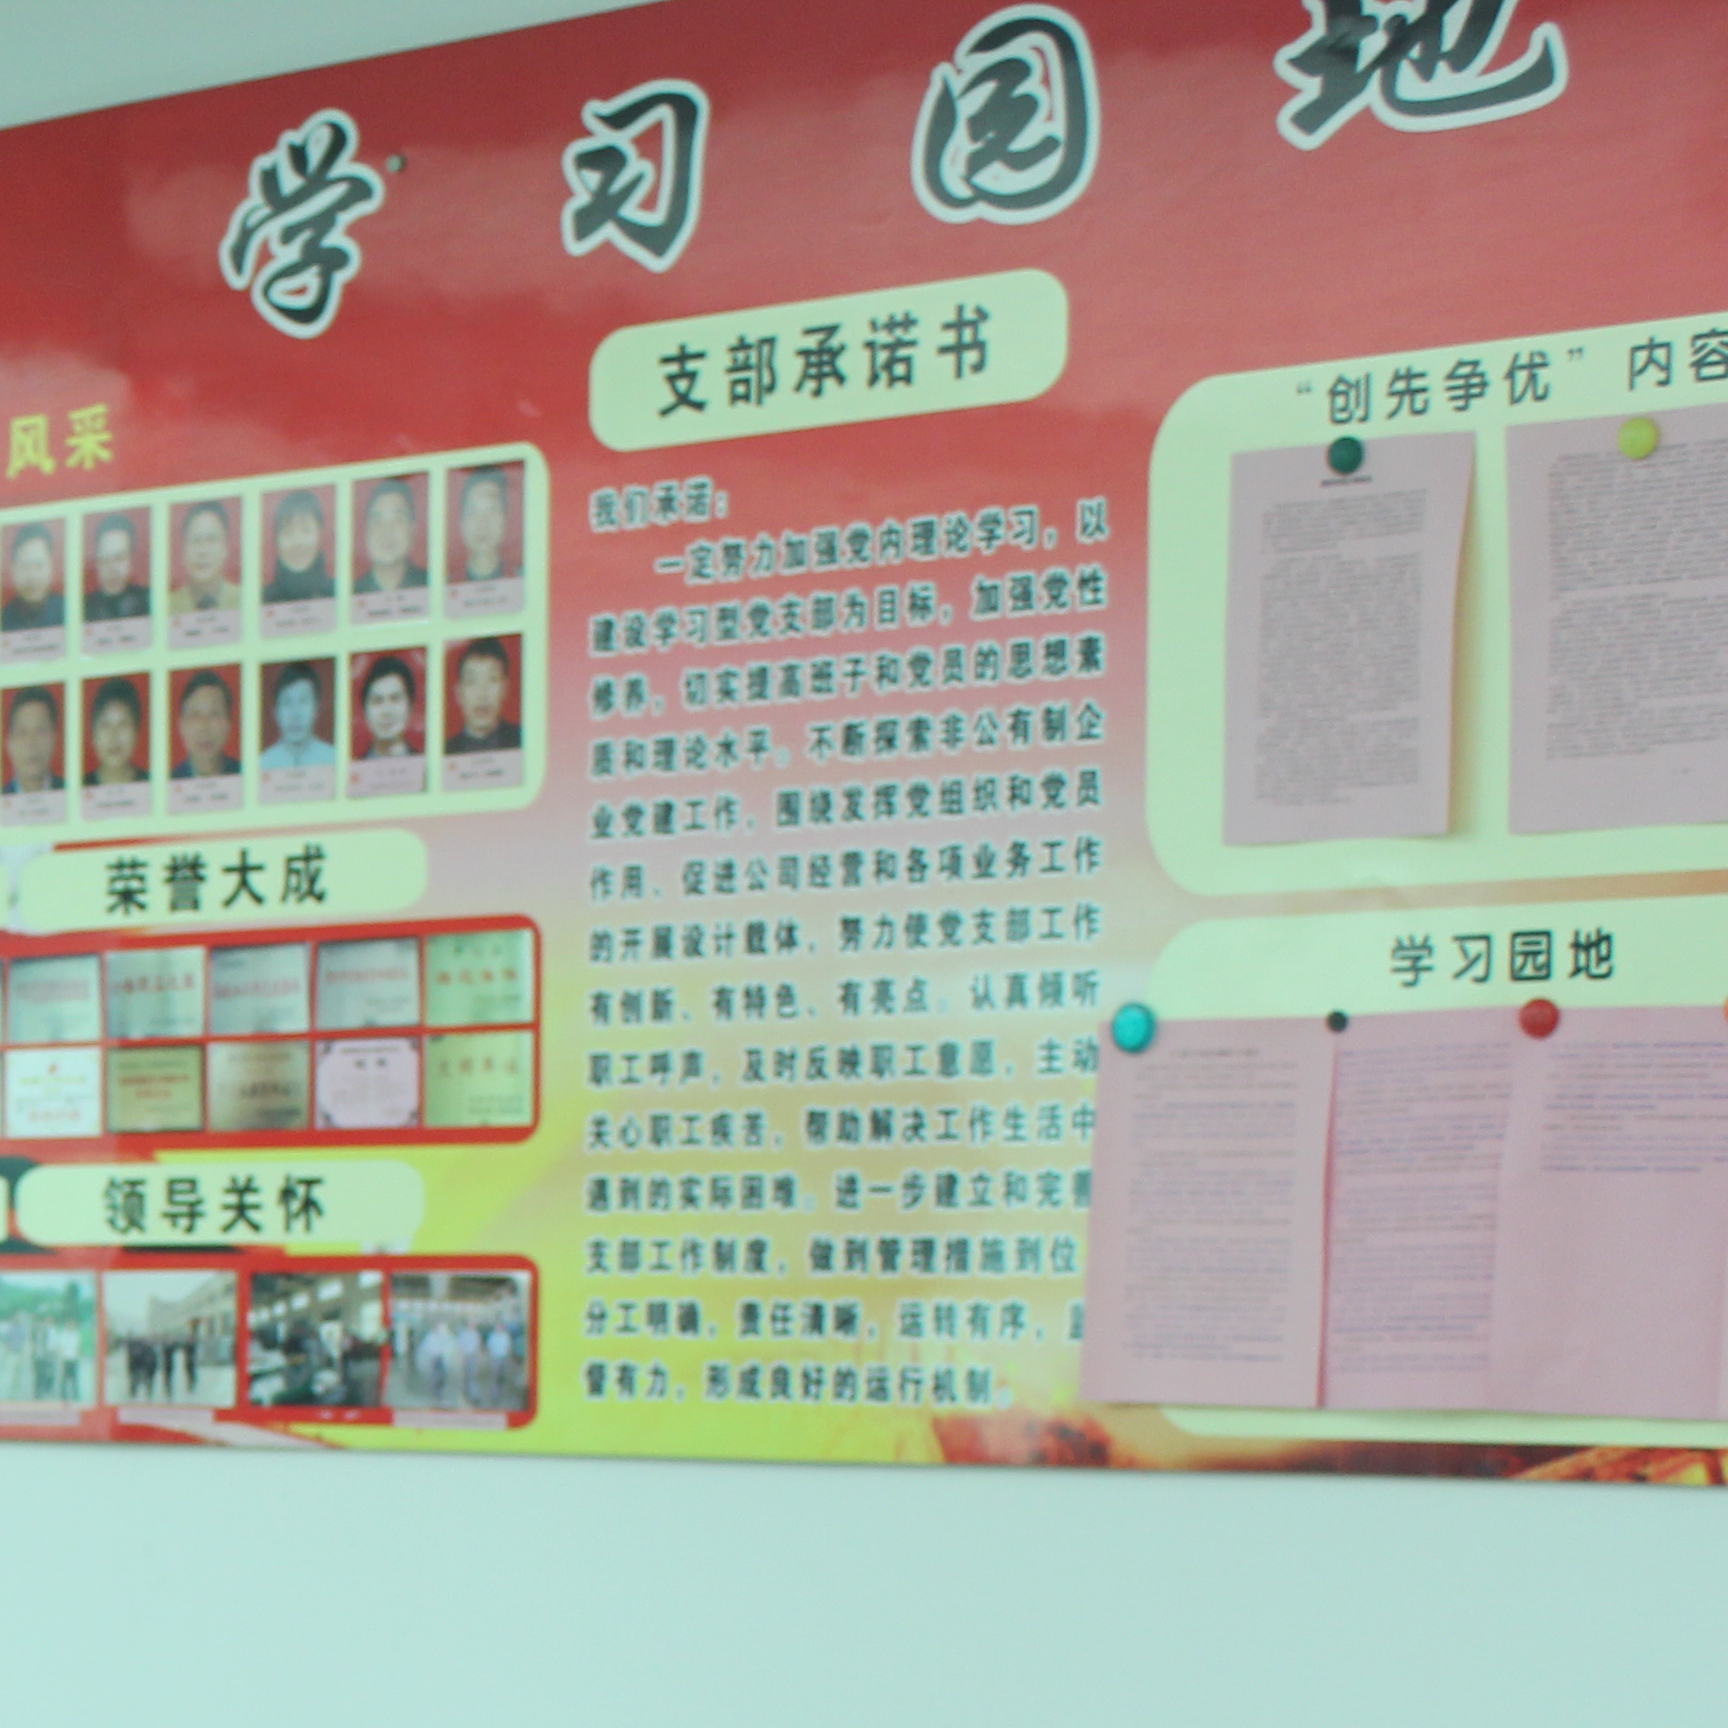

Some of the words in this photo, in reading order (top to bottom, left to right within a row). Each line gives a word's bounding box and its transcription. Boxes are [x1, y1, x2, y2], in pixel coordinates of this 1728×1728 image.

[658, 303, 990, 419] 支部承诺书
[105, 842, 327, 915] 荣誉大成
[1390, 926, 1615, 988] 学习园地
[102, 1174, 325, 1234] 领导关怀
